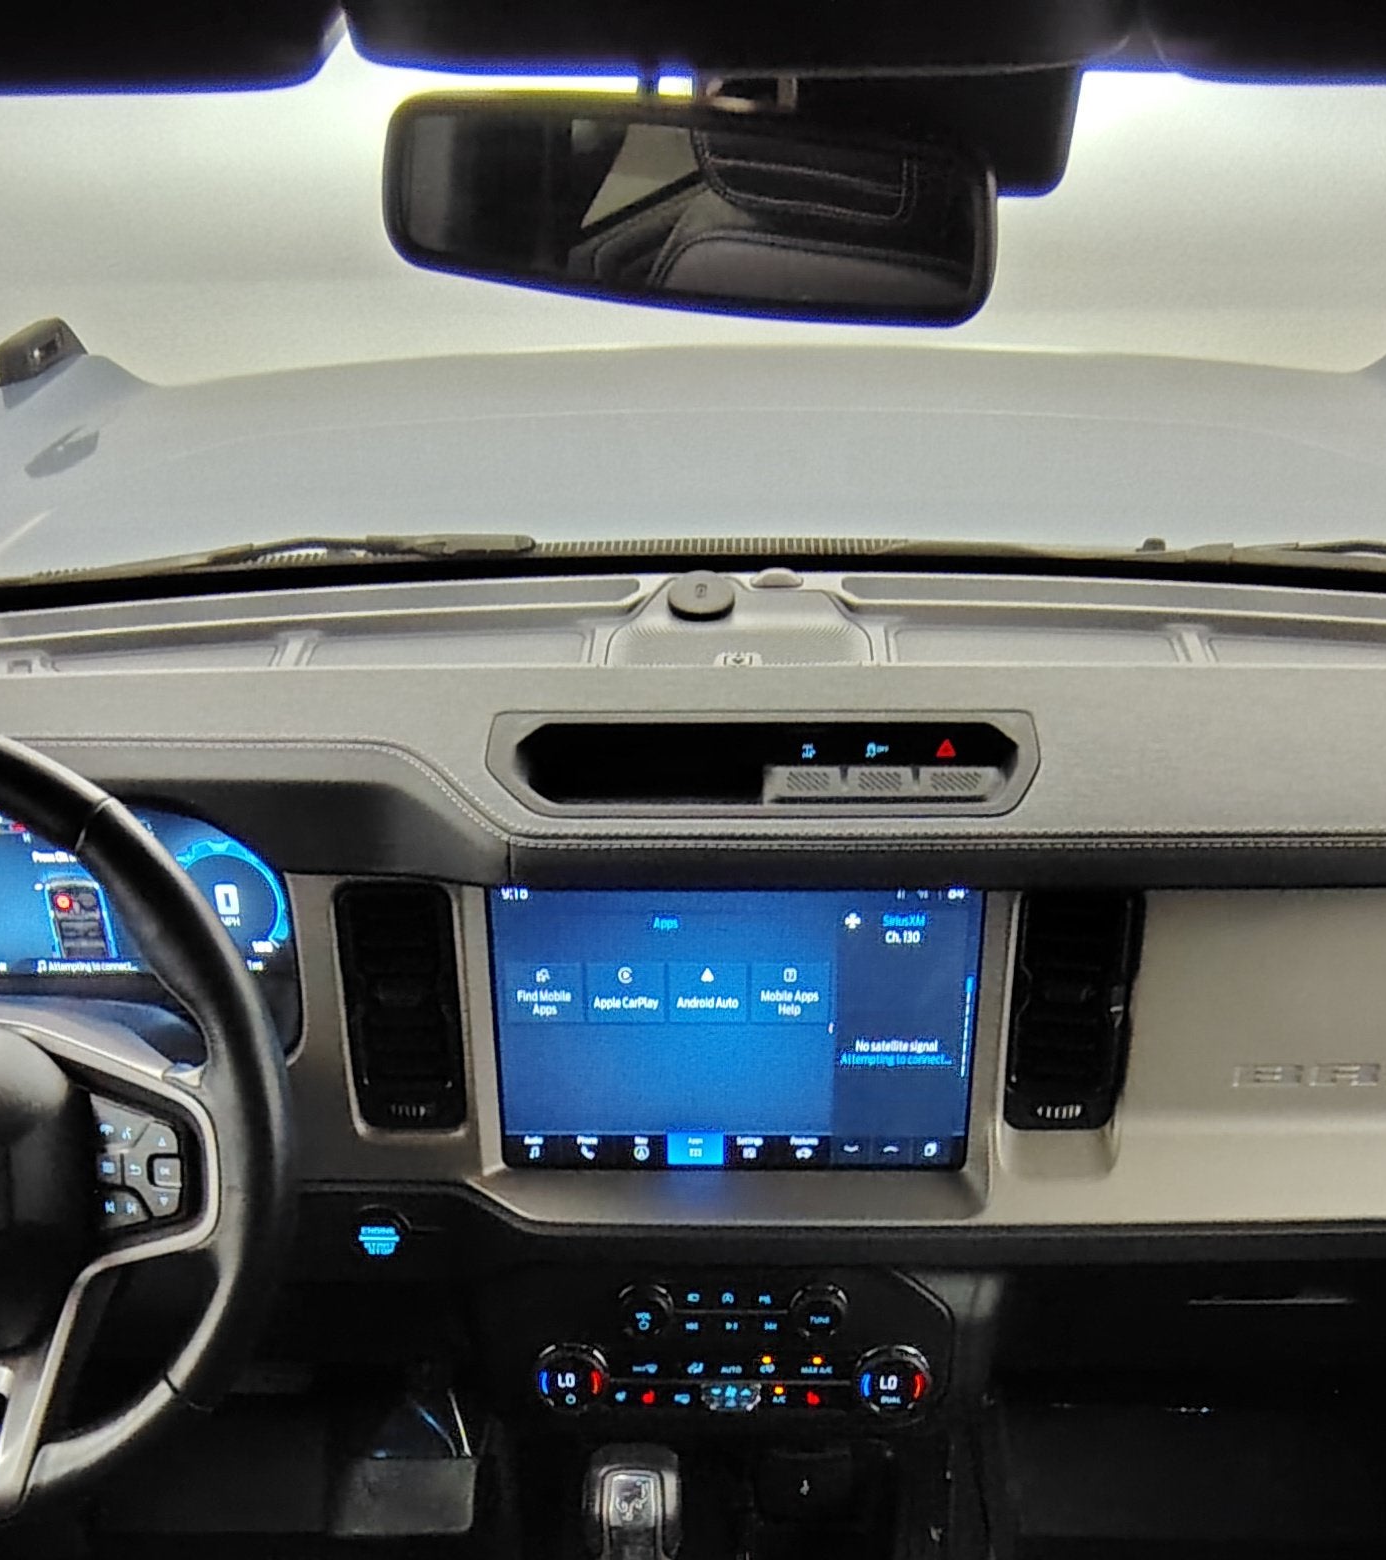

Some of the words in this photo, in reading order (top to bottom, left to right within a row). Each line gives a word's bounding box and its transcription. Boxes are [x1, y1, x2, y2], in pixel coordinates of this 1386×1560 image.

[214, 884, 240, 915] 0
[652, 916, 679, 930] Apps
[882, 913, 926, 927] SiriusXM
[517, 989, 538, 1002] Find
[539, 989, 572, 1002] Mobile
[760, 989, 793, 1002] Mobile
[794, 989, 819, 1004] Apps
[593, 996, 621, 1011] Apple
[622, 996, 659, 1011] CarPlay
[676, 996, 714, 1010] Android
[715, 996, 739, 1009] Auto
[532, 1004, 558, 1017] Apps
[777, 1004, 801, 1017] Help
[855, 1039, 870, 1052] No
[870, 1039, 909, 1052] satellite
[909, 1039, 939, 1054] signal
[839, 1053, 895, 1067] Attempting
[557, 1372, 576, 1389] LO
[879, 1374, 898, 1391] LO
